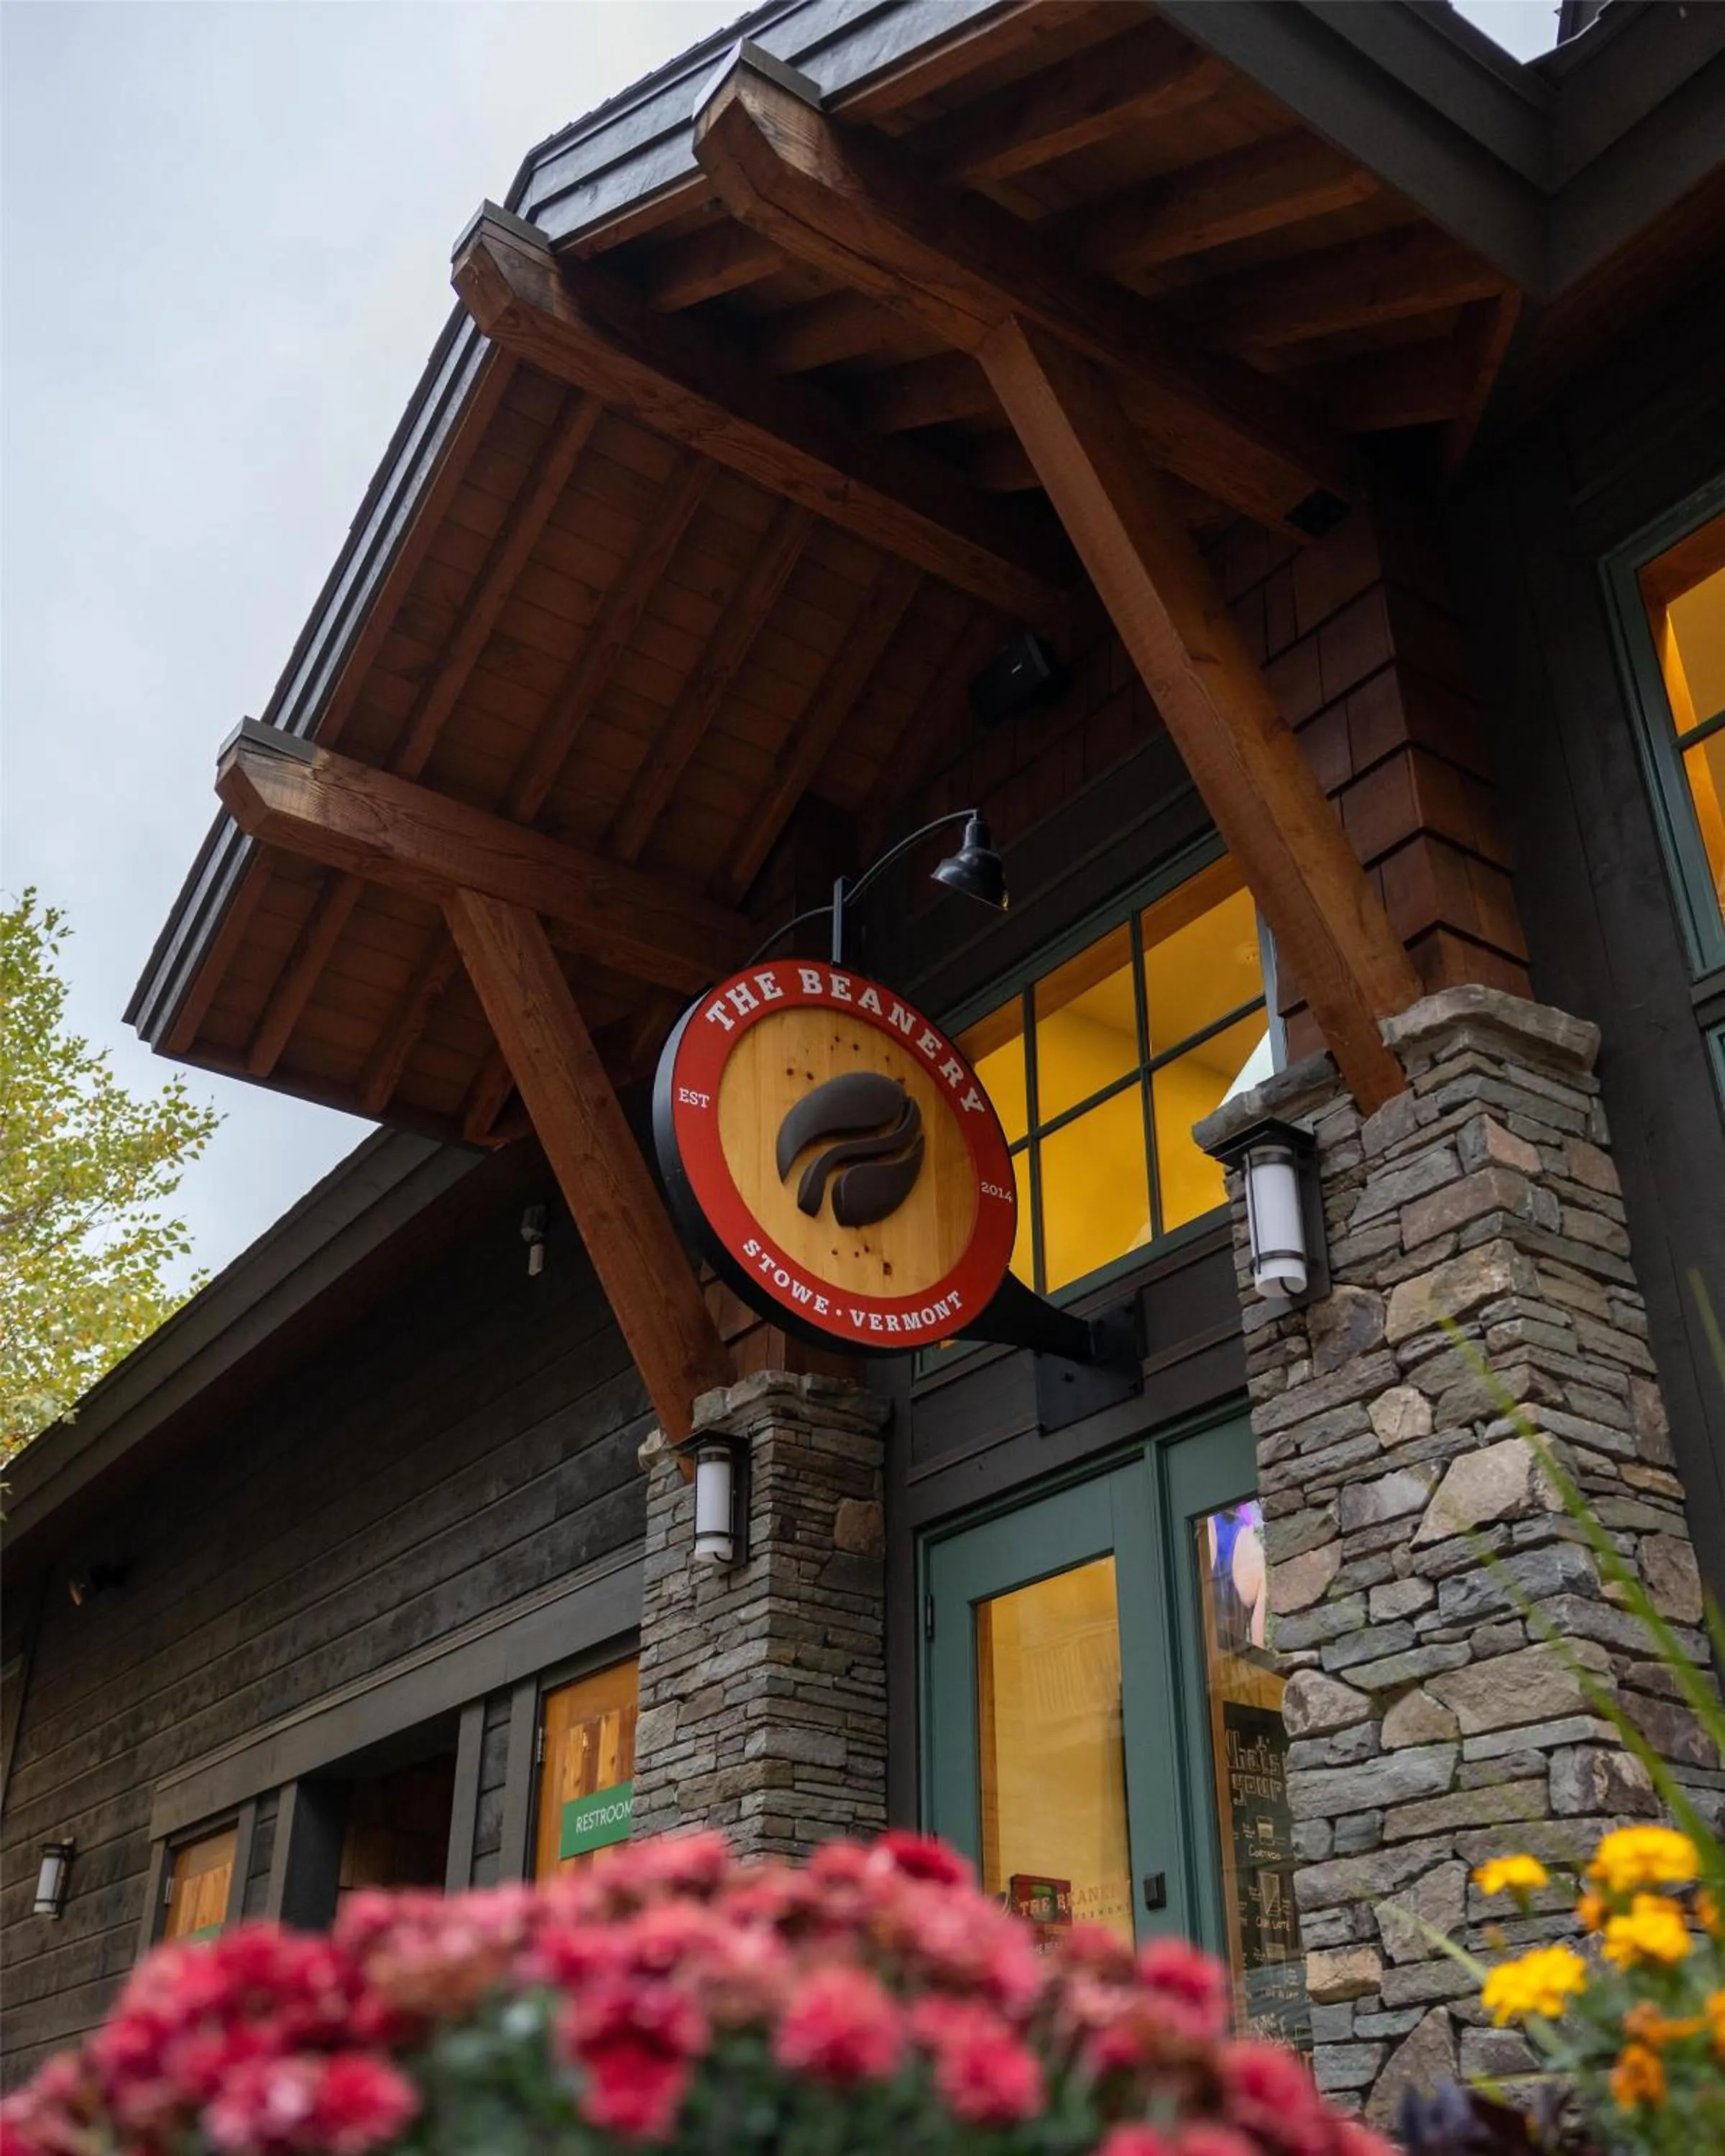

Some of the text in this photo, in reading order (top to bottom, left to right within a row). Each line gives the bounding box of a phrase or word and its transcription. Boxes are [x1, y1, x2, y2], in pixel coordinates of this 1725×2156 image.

[705, 968, 985, 1113] THE BEANERY
[678, 1087, 710, 1108] EST
[981, 1181, 1013, 1202] 2014
[742, 1238, 963, 1332] STOWE VERMONT
